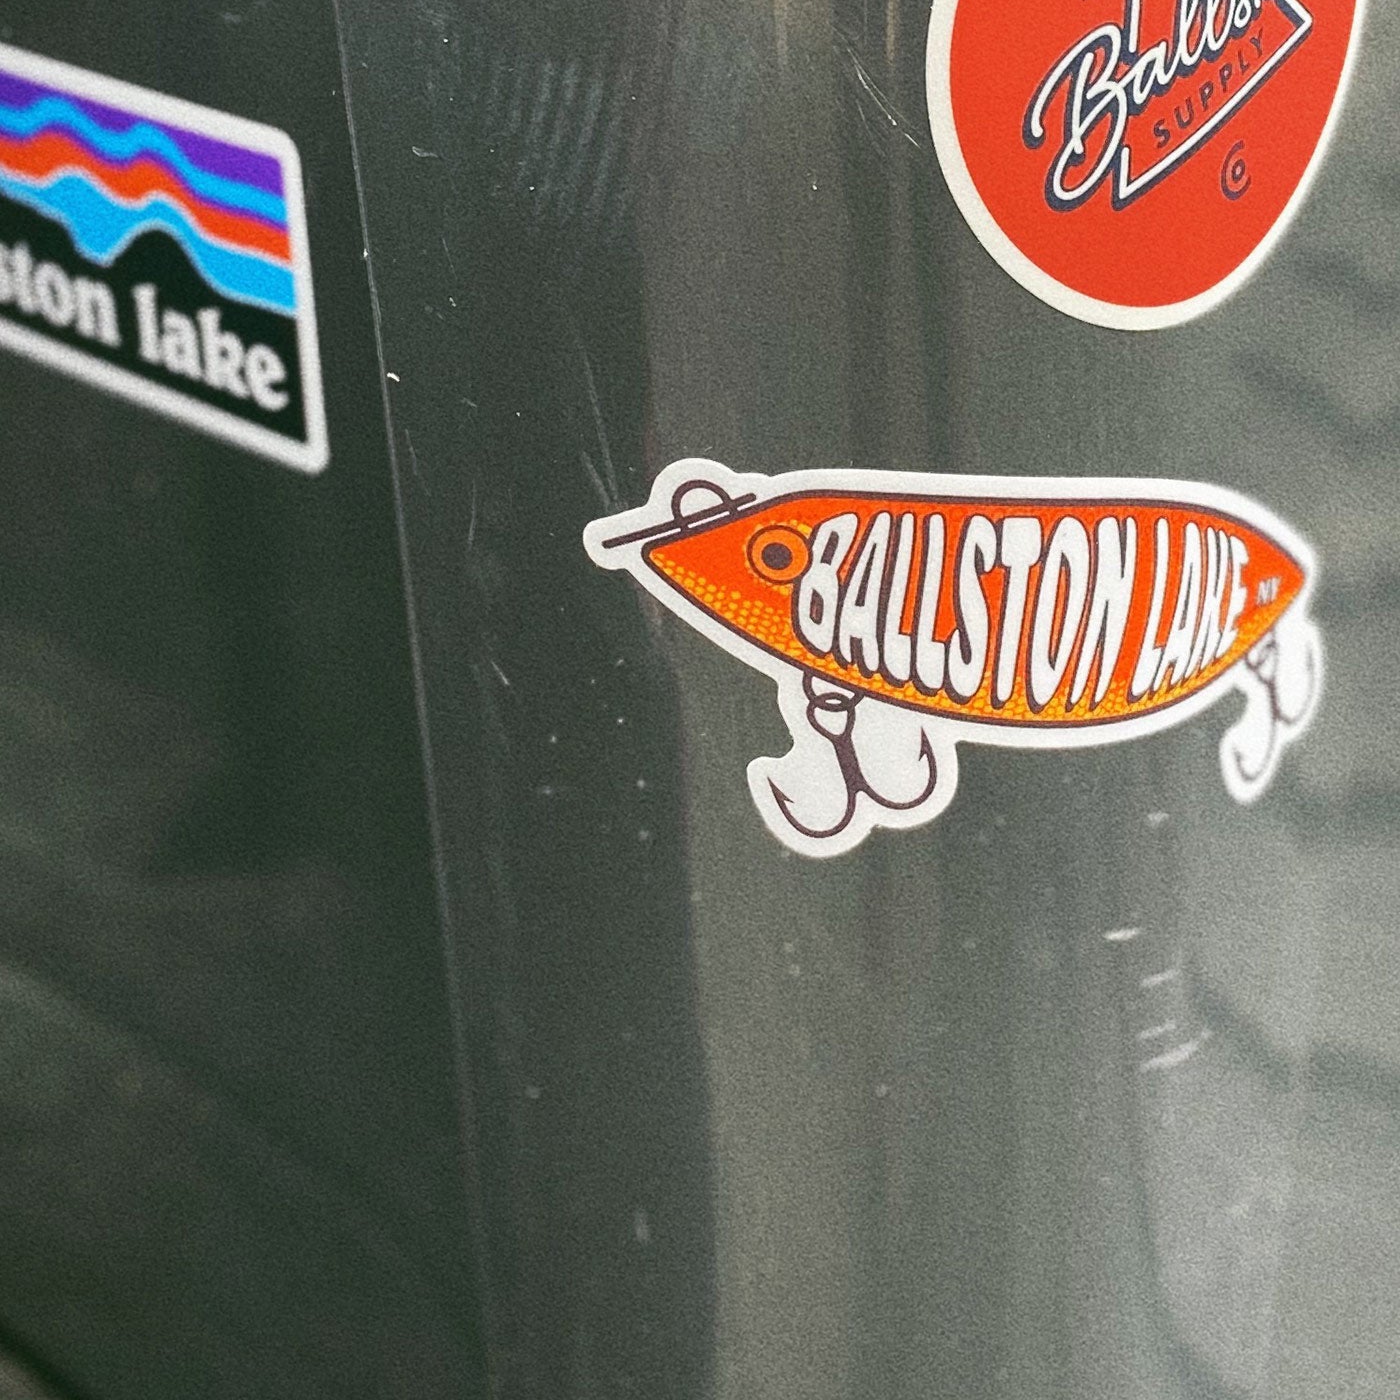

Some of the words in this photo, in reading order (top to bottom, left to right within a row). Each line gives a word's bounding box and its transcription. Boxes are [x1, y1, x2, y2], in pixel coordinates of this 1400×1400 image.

[1153, 27, 1264, 149] SUPPLY
[131, 283, 291, 412] lake
[794, 510, 1137, 713] BALLSTON
[1130, 518, 1250, 698] LAKE
[1255, 576, 1282, 607] NY
